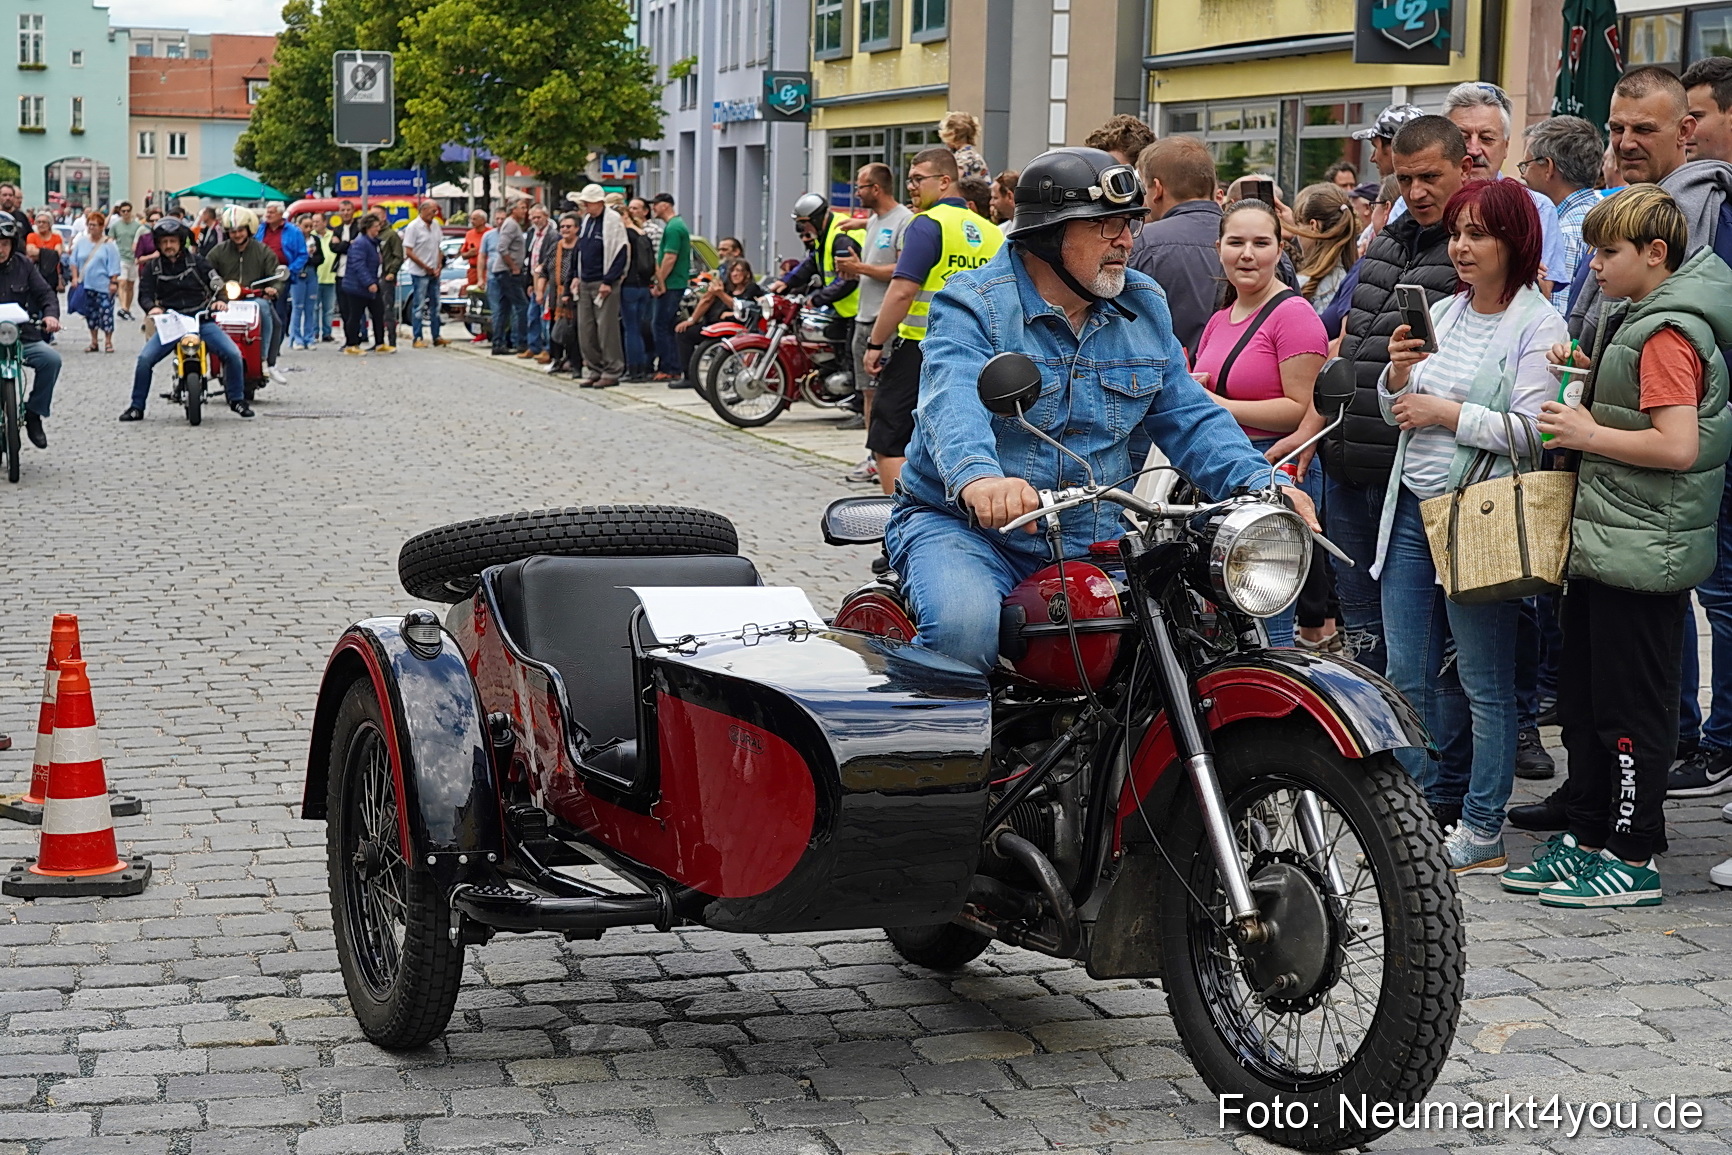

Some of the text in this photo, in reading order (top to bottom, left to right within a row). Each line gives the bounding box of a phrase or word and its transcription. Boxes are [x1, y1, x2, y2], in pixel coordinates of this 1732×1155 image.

[1395, 0, 1428, 31] G2
[780, 84, 798, 106] G2
[948, 254, 991, 271] FOLLO
